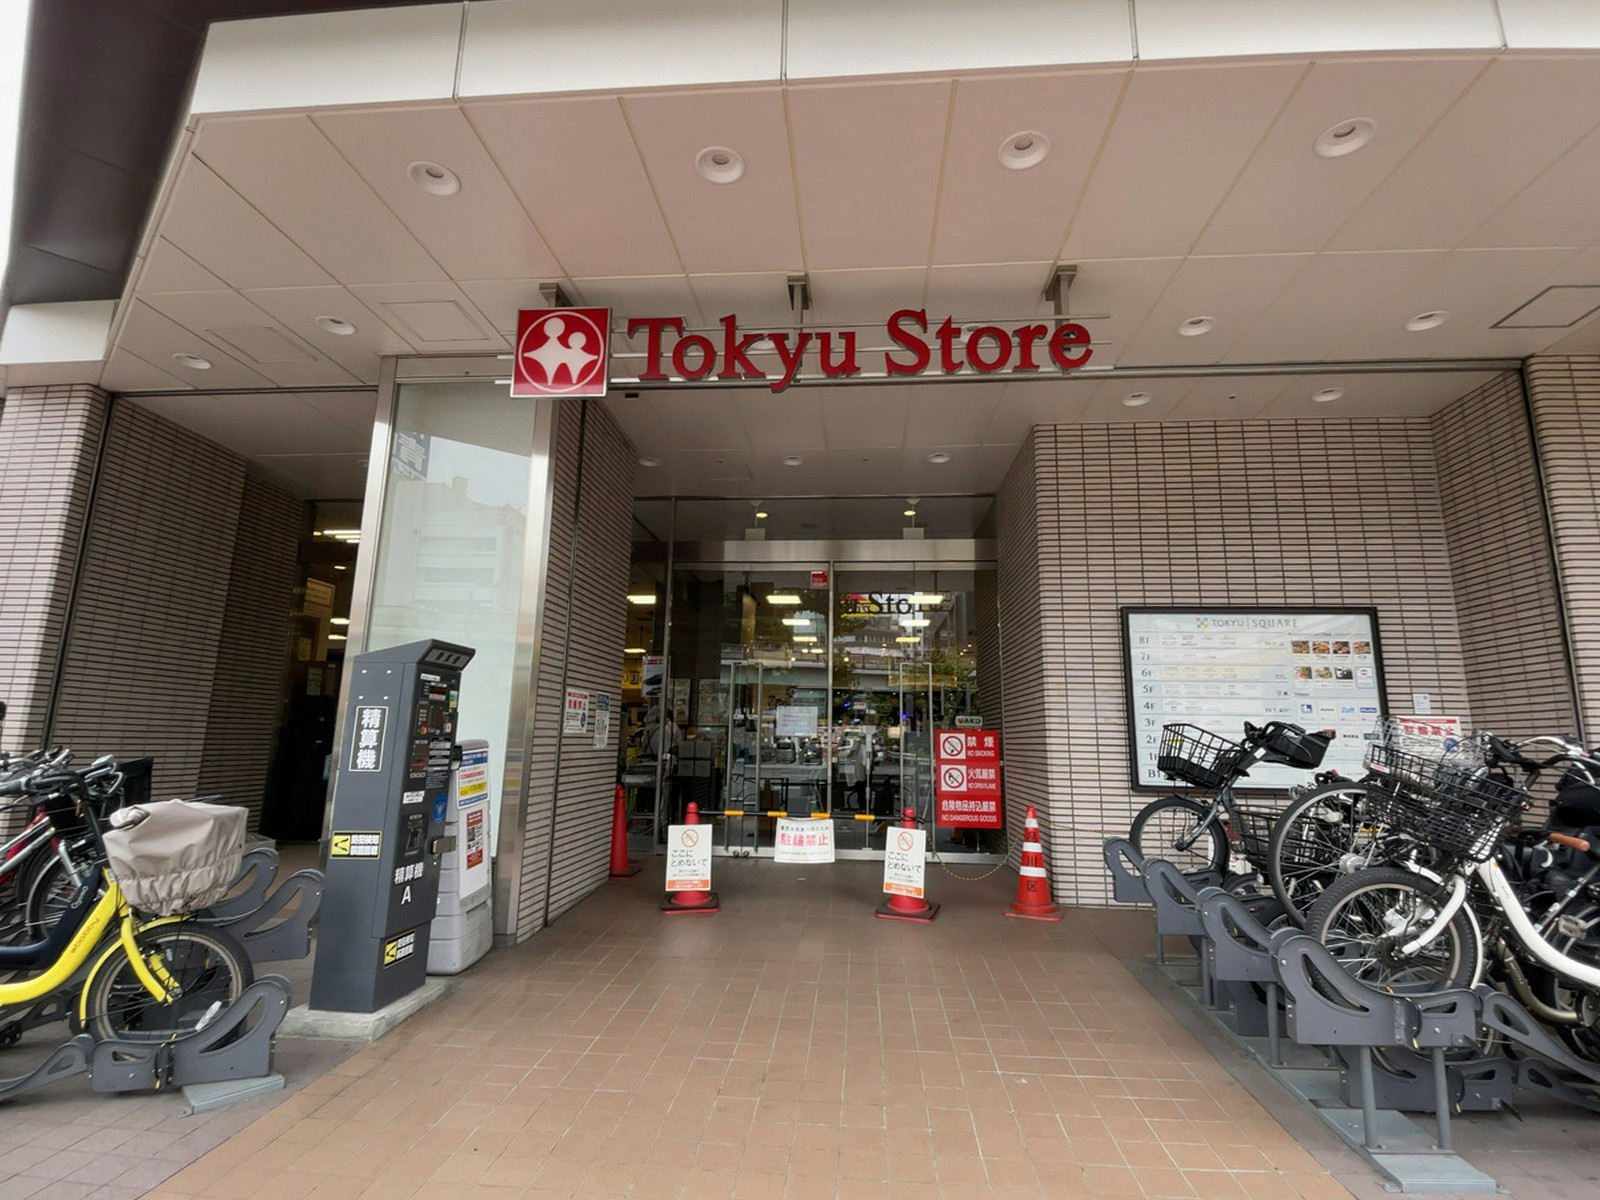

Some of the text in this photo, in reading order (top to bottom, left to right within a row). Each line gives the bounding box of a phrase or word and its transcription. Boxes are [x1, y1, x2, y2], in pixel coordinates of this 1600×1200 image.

[627, 308, 1093, 393] Tokyu Store
[1211, 618, 1298, 629] TOKYU SQUARE
[1139, 636, 1149, 645] 8F
[1141, 653, 1150, 662] 7F
[1141, 669, 1152, 677] 6F
[1143, 685, 1153, 694] 5F
[1143, 702, 1155, 710] 4F
[1145, 718, 1156, 727] 3F
[356, 708, 382, 769] 精算機
[1146, 735, 1157, 744] 2F
[975, 750, 996, 758] SMOKING
[968, 768, 996, 780] 火気厳禁
[941, 800, 996, 812] 危険物品持込厳禁
[950, 814, 979, 822] DANGEROUS
[979, 815, 997, 823] GOODS
[780, 833, 829, 847] 駐輪禁止
[671, 850, 694, 858] ここに
[888, 851, 908, 862] ここに
[671, 858, 708, 867] とめないで
[887, 861, 922, 873] とめないで
[394, 862, 424, 885] 精算機
[400, 885, 412, 906] A
